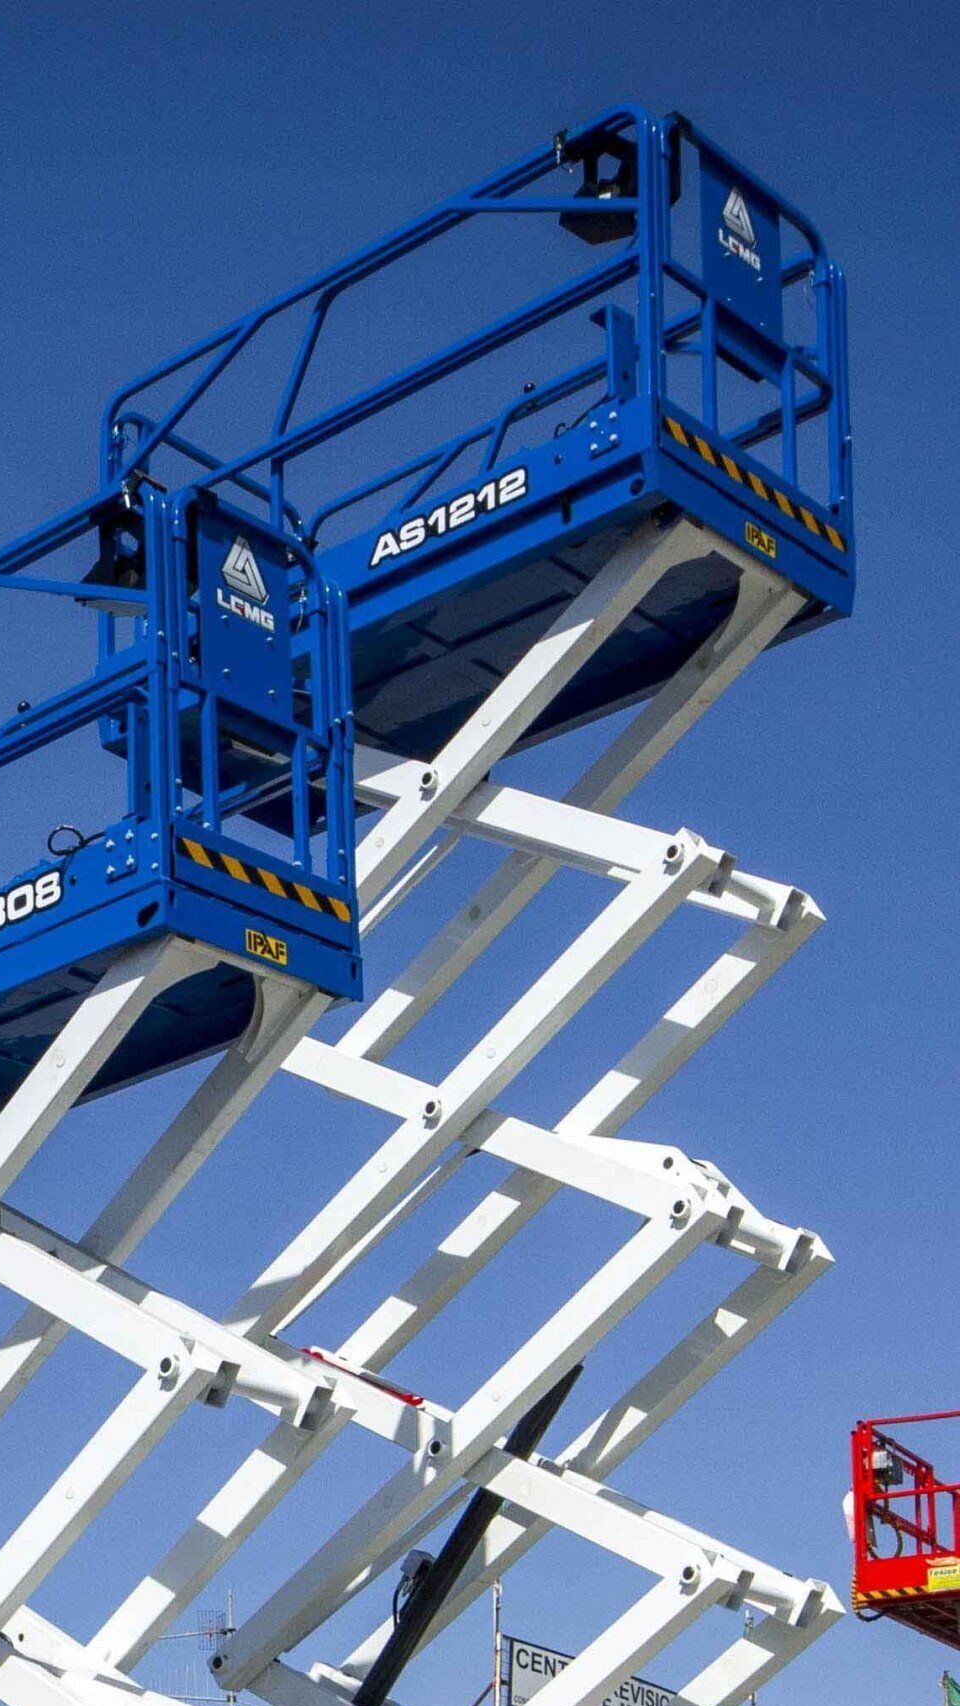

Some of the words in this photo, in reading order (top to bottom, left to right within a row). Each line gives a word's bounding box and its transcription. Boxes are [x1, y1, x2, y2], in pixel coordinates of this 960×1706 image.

[718, 227, 760, 271] LCMG
[371, 468, 526, 566] AS1212
[747, 524, 775, 556] IPAF
[217, 588, 274, 632] LCMG
[247, 931, 286, 961] IPAF
[516, 1648, 568, 1678] CENT
